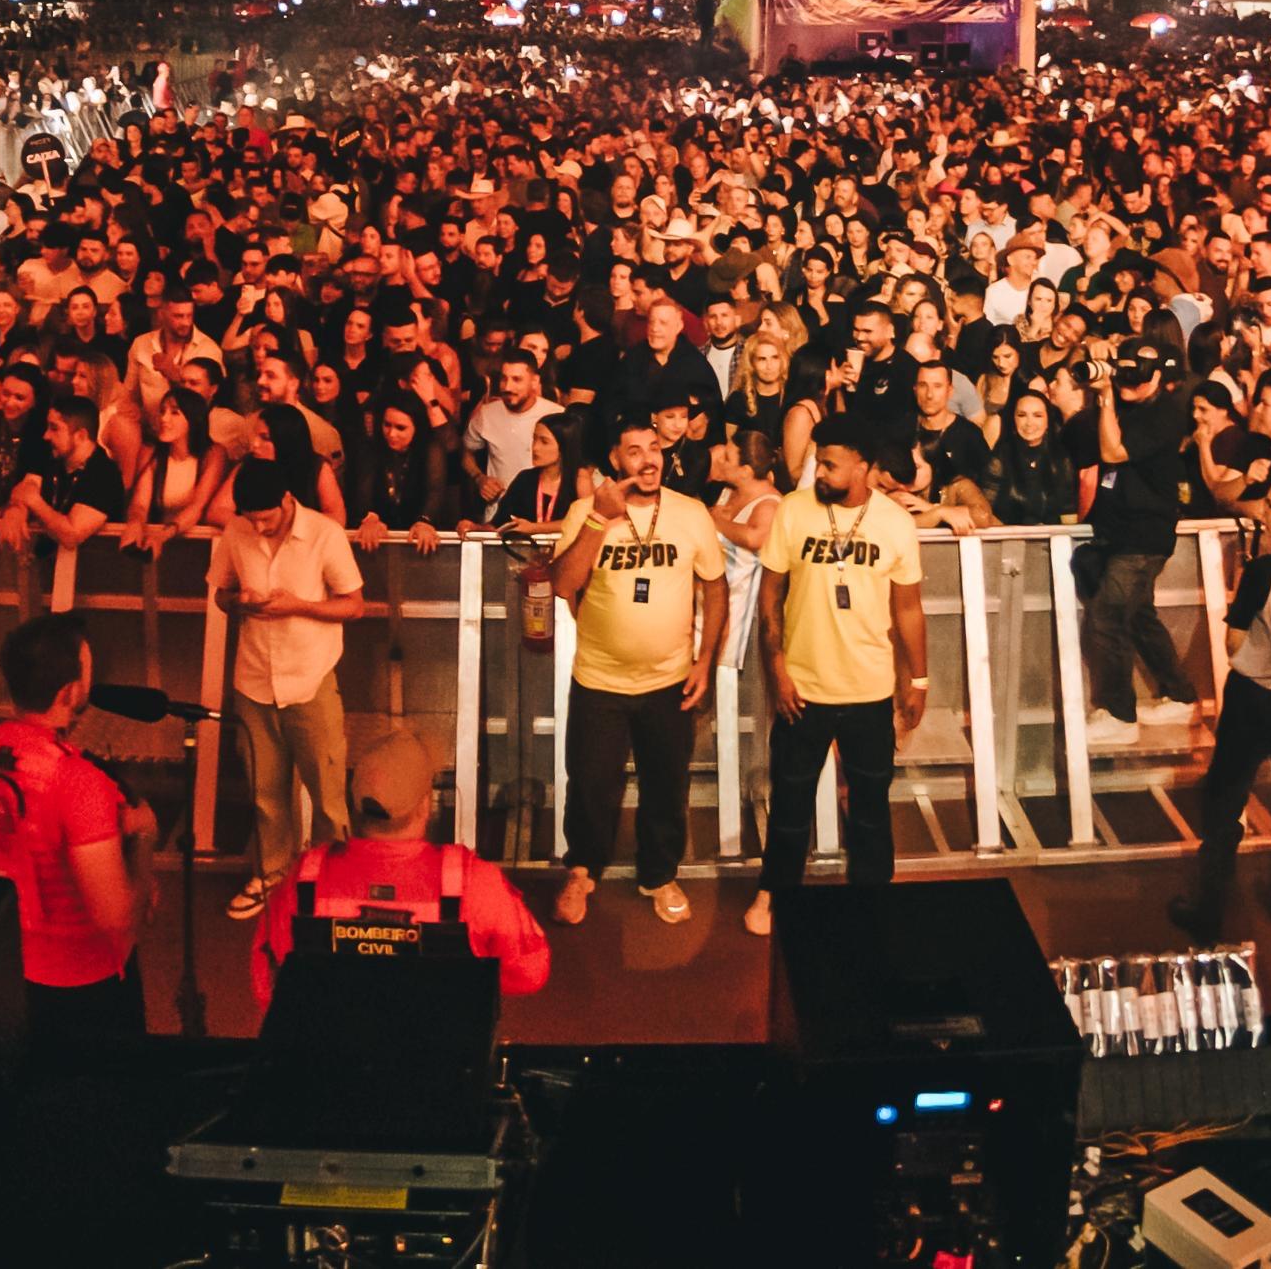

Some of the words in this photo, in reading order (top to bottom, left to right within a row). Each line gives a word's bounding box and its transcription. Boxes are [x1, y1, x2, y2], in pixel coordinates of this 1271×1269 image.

[26, 150, 60, 163] CAIXA
[598, 542, 678, 570] FESPOP
[335, 925, 419, 942] BOMBEIRO
[357, 942, 397, 955] CIVIL
